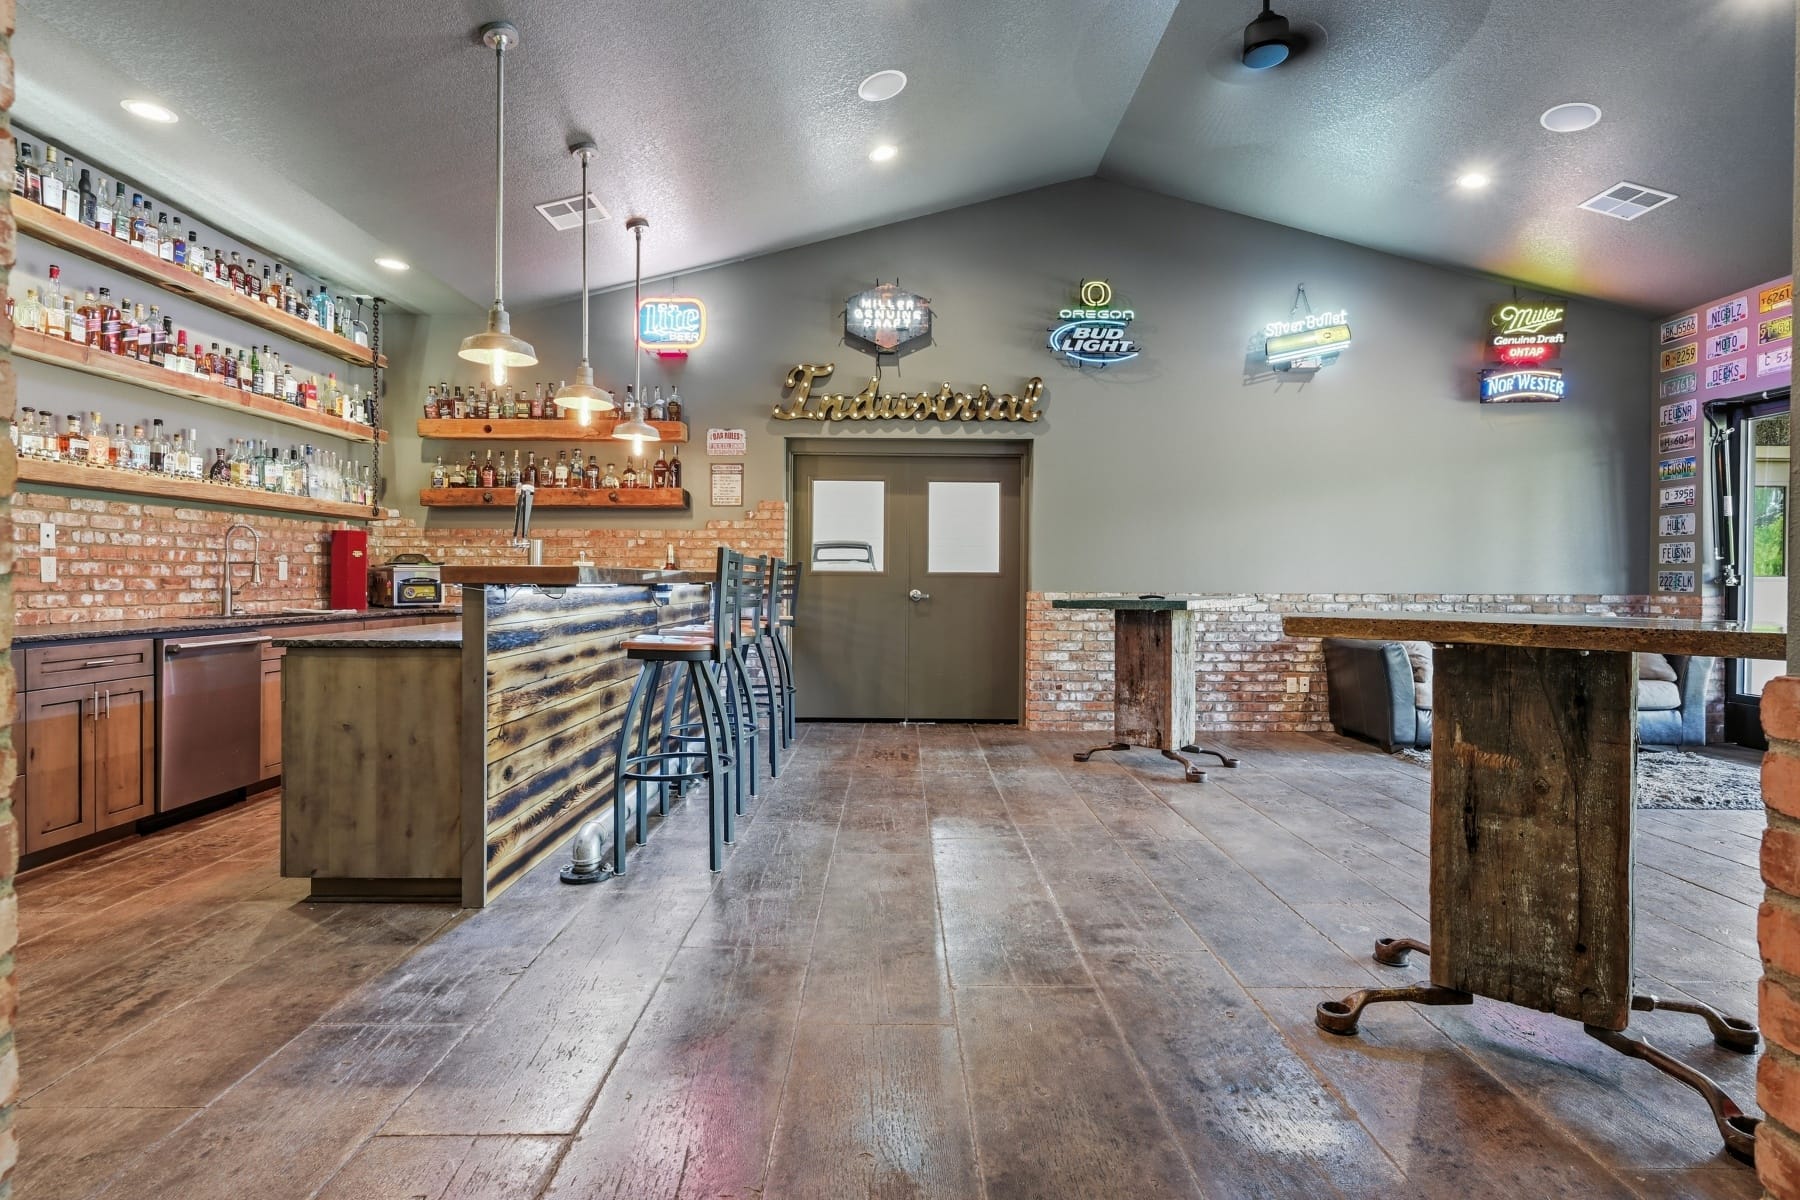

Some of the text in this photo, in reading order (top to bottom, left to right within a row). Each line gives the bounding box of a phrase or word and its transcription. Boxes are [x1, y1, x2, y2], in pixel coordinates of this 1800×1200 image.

[644, 303, 700, 335] Lite
[1059, 309, 1135, 320] OREGON
[1265, 309, 1348, 337] Silver Bullet
[1500, 306, 1563, 332] Miller
[1072, 327, 1124, 340] BUD
[1493, 333, 1565, 346] Genuine Draft
[1061, 339, 1134, 352] LIGHT
[772, 363, 1043, 422] Industrial
